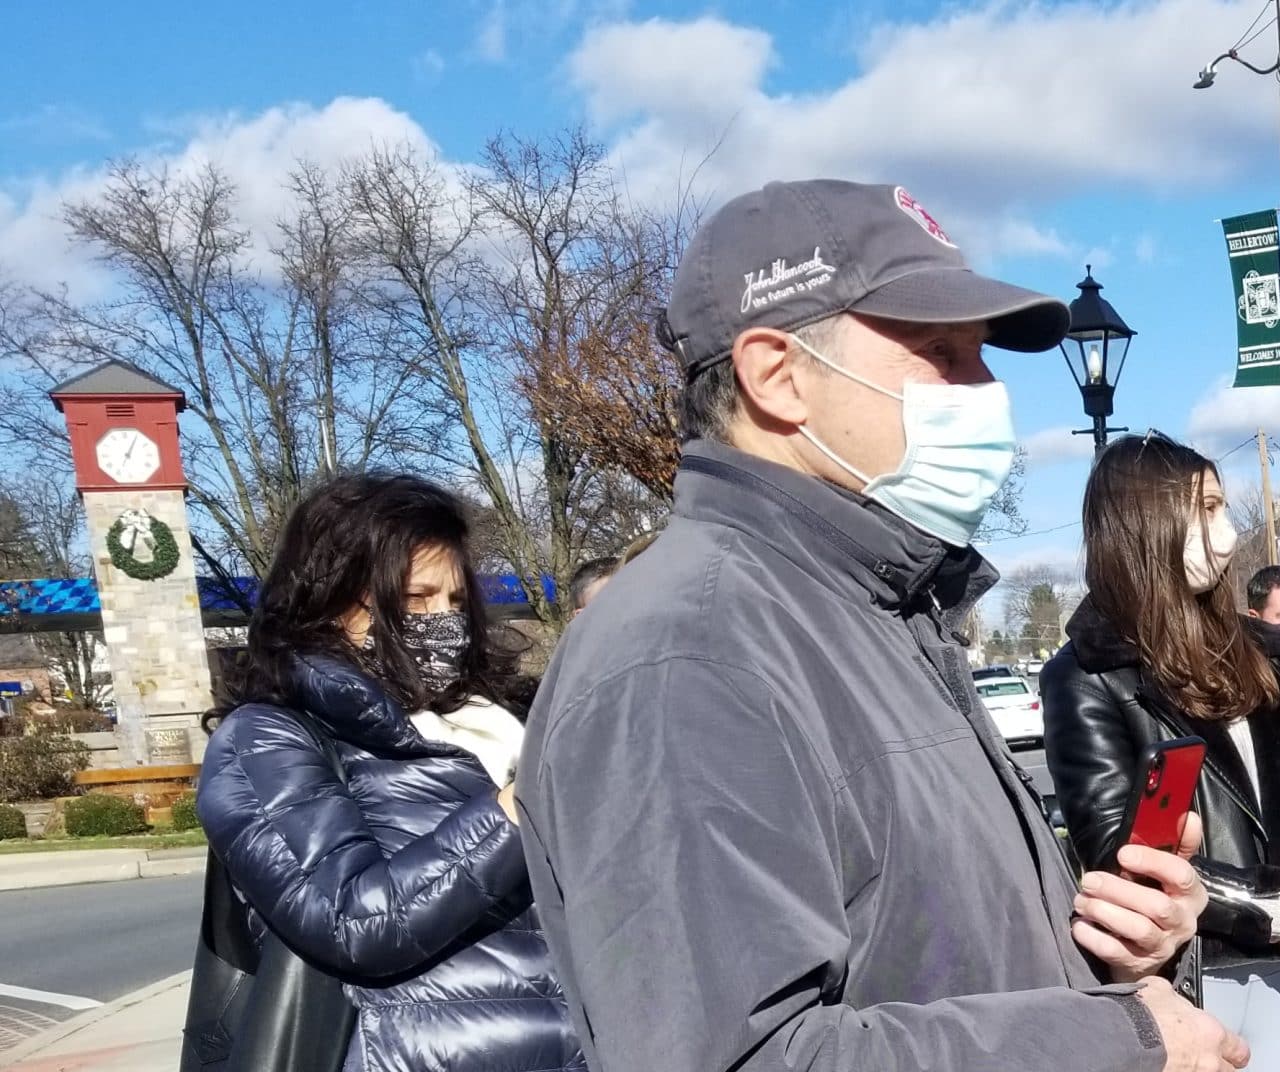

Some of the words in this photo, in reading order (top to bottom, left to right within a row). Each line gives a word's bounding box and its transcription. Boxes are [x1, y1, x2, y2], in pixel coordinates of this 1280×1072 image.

[741, 269, 774, 313] John
[772, 246, 836, 284] Hancock
[752, 296, 768, 308] the
[768, 286, 796, 302] future
[795, 282, 806, 292] is
[805, 272, 832, 291] yours
[1240, 350, 1274, 363] WELCOMES
